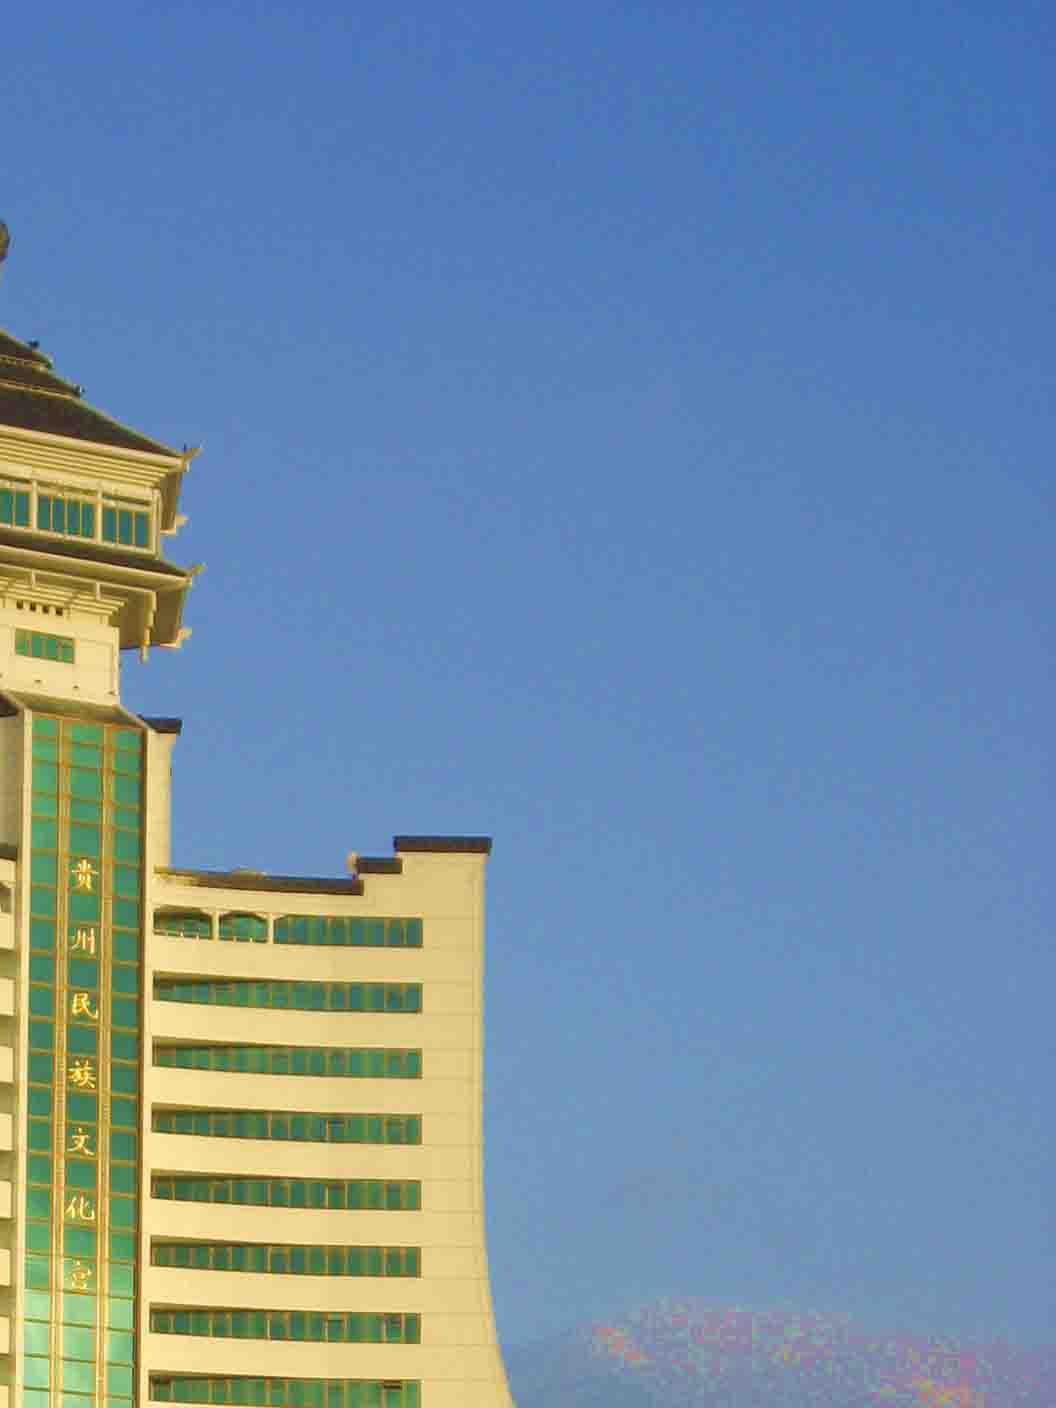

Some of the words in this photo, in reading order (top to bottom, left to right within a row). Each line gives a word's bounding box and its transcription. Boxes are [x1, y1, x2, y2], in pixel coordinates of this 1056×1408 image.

[66, 859, 99, 1292] 贵州民族文化宫
